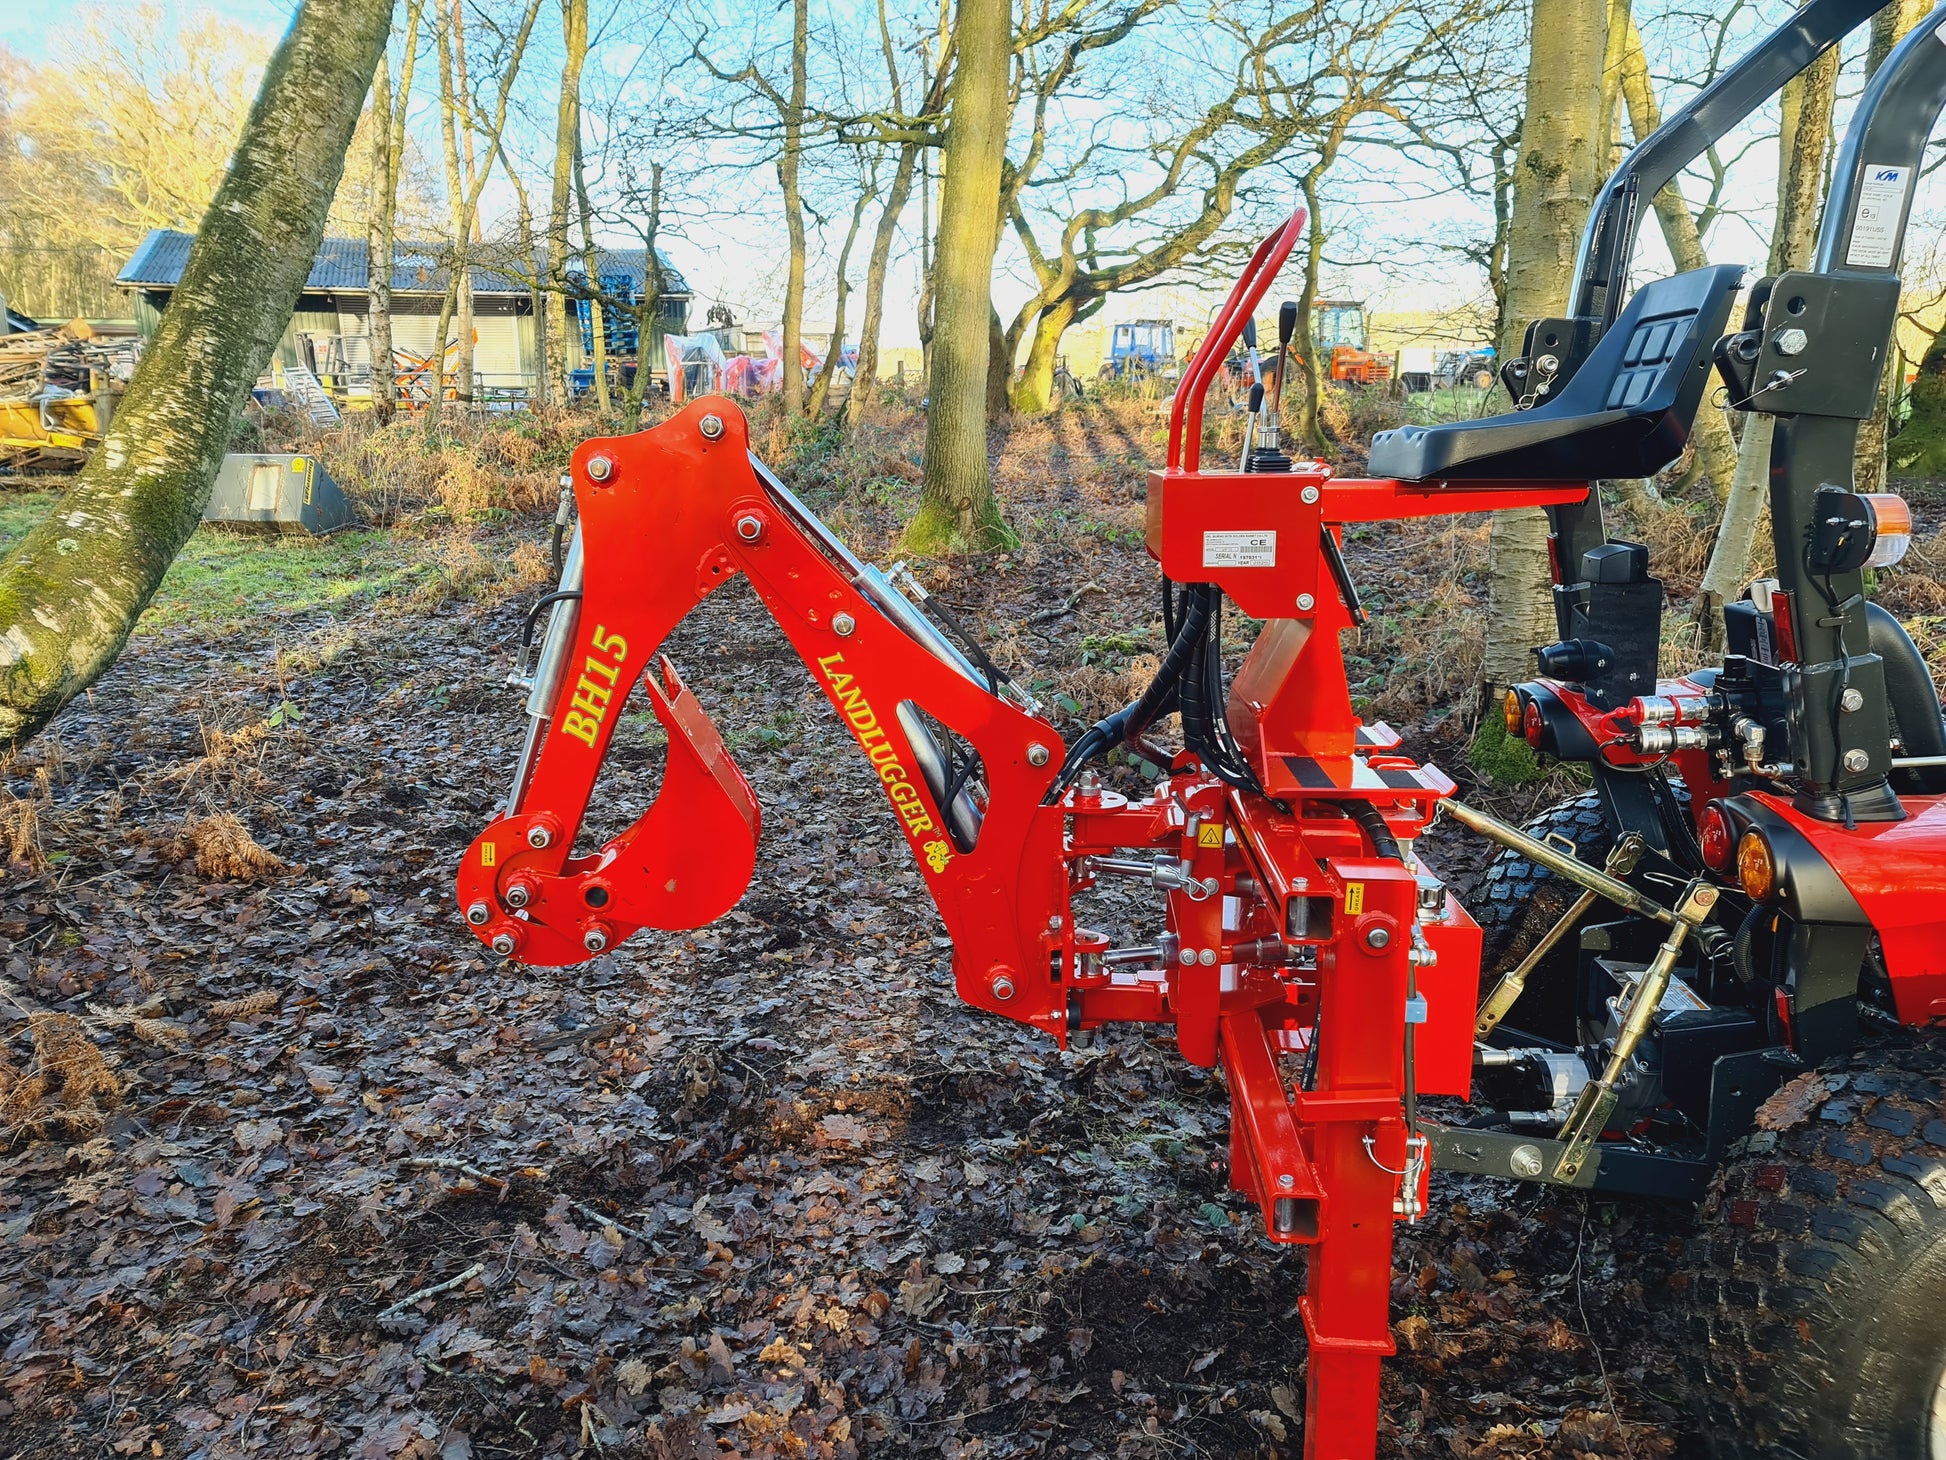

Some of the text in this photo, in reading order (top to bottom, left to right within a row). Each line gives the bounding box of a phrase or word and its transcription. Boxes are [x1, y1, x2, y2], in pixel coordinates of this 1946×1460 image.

[1875, 170, 1899, 182] KM
[561, 623, 628, 749] BH15
[817, 651, 934, 838] LANDLUGGER
